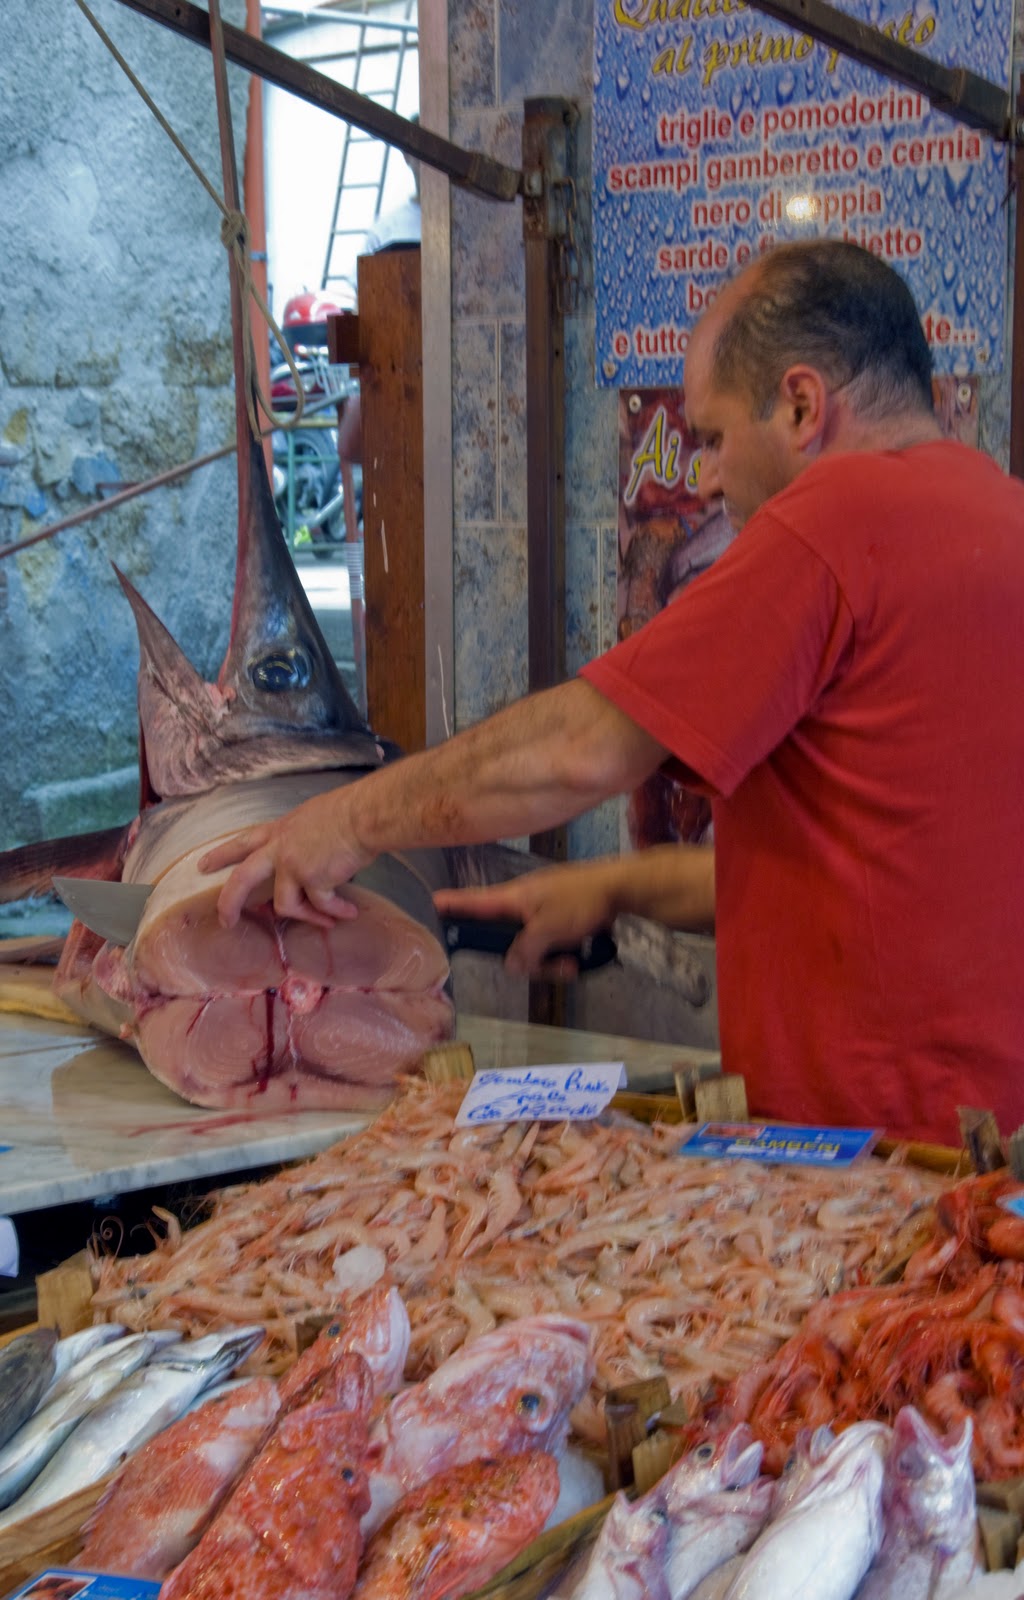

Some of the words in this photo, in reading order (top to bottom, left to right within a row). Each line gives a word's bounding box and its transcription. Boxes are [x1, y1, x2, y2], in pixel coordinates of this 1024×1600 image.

[652, 34, 693, 76] al
[702, 30, 815, 87] primo
[660, 108, 731, 148] triglie
[740, 112, 754, 136] e
[764, 89, 922, 141] pomodorini
[610, 154, 698, 192] scampi
[707, 141, 858, 190] gamberetto
[867, 144, 882, 170] e
[893, 126, 980, 167] cernia
[693, 200, 750, 226] nero
[759, 190, 782, 221] di
[659, 240, 728, 271] sarde
[737, 244, 750, 263] e
[615, 333, 628, 356] e
[637, 328, 691, 355] tutto
[626, 410, 680, 500] Ai
